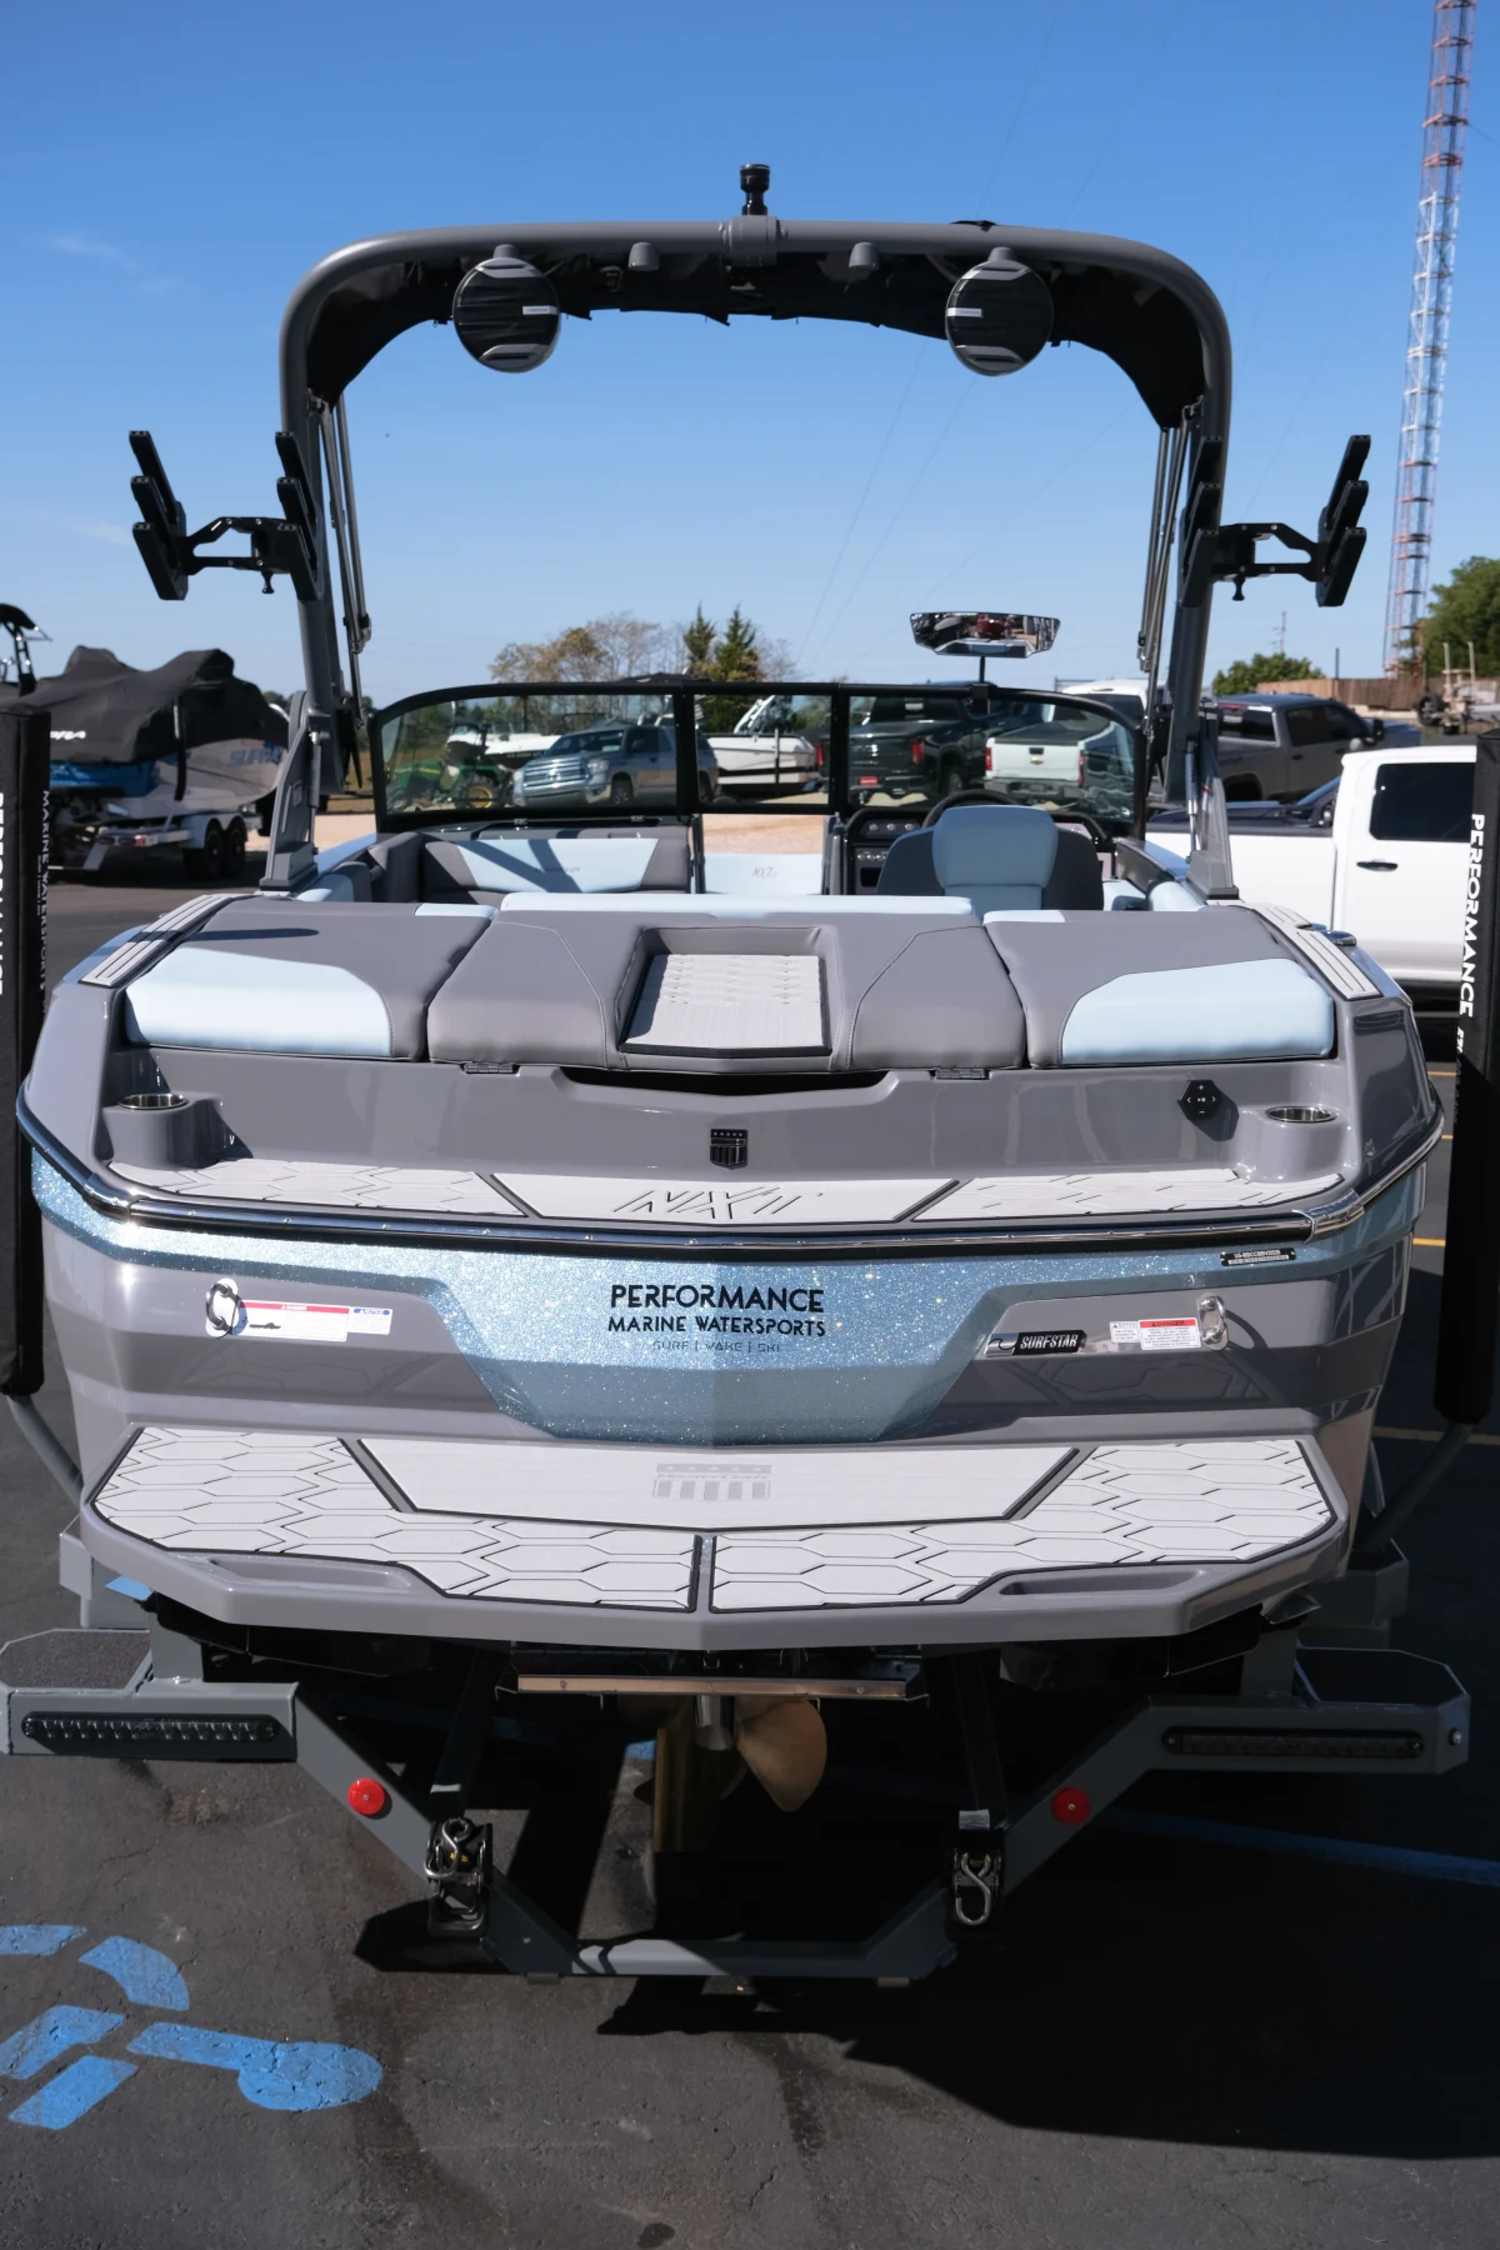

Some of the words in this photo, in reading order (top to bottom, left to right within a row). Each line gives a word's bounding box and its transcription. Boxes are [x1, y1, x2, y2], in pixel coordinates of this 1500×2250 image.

[42, 790, 50, 864] MARINE
[1459, 813, 1486, 1018] PERFORMANCE
[610, 1284, 825, 1313] PERFORMANCE
[608, 1316, 687, 1333] MARINE
[695, 1315, 826, 1337] WATERSPORTS
[653, 1340, 689, 1351] SURF
[757, 1343, 781, 1353] SKI
[1019, 1333, 1079, 1350] SURFSTAR
